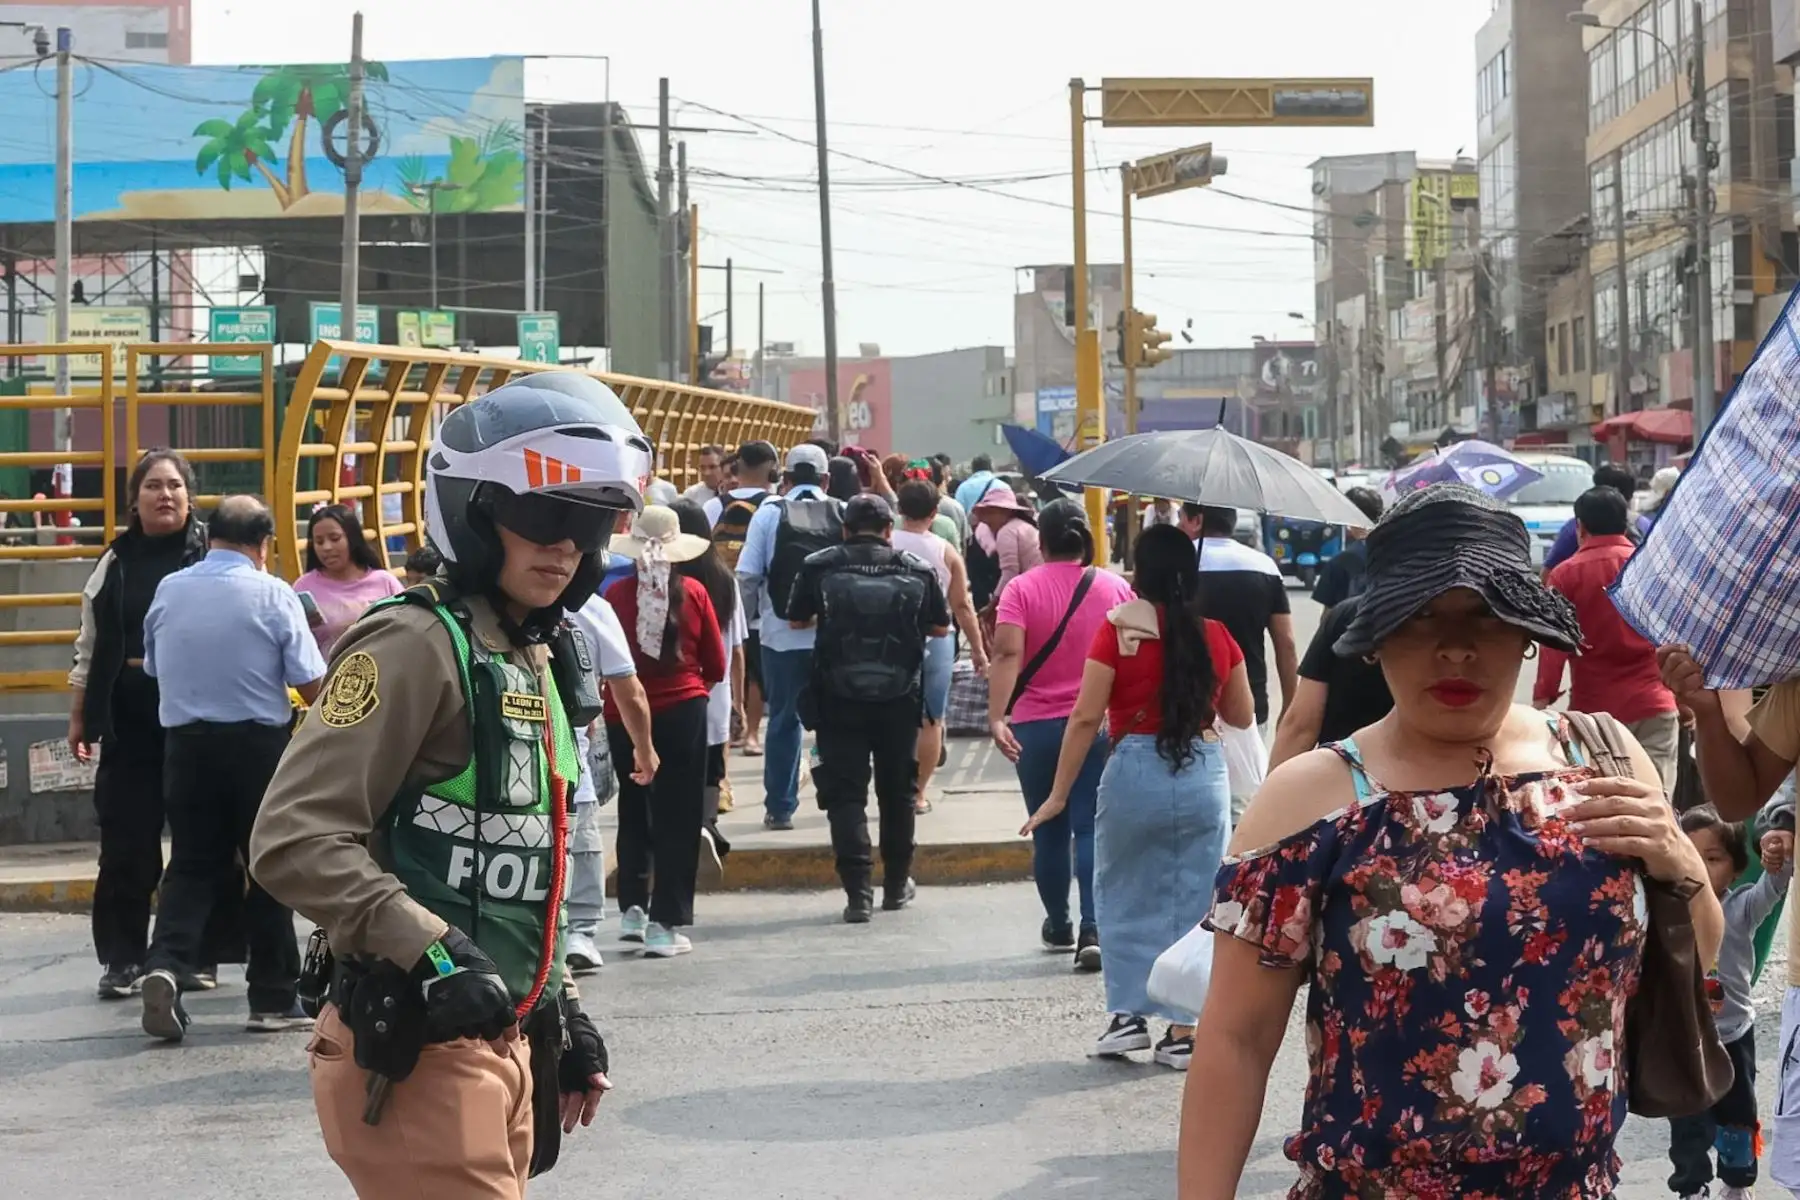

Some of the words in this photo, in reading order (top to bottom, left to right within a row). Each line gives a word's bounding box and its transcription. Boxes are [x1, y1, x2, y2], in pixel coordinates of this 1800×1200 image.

[218, 324, 265, 336] PUERTA
[319, 324, 372, 339] INGSO
[535, 342, 547, 363] 3
